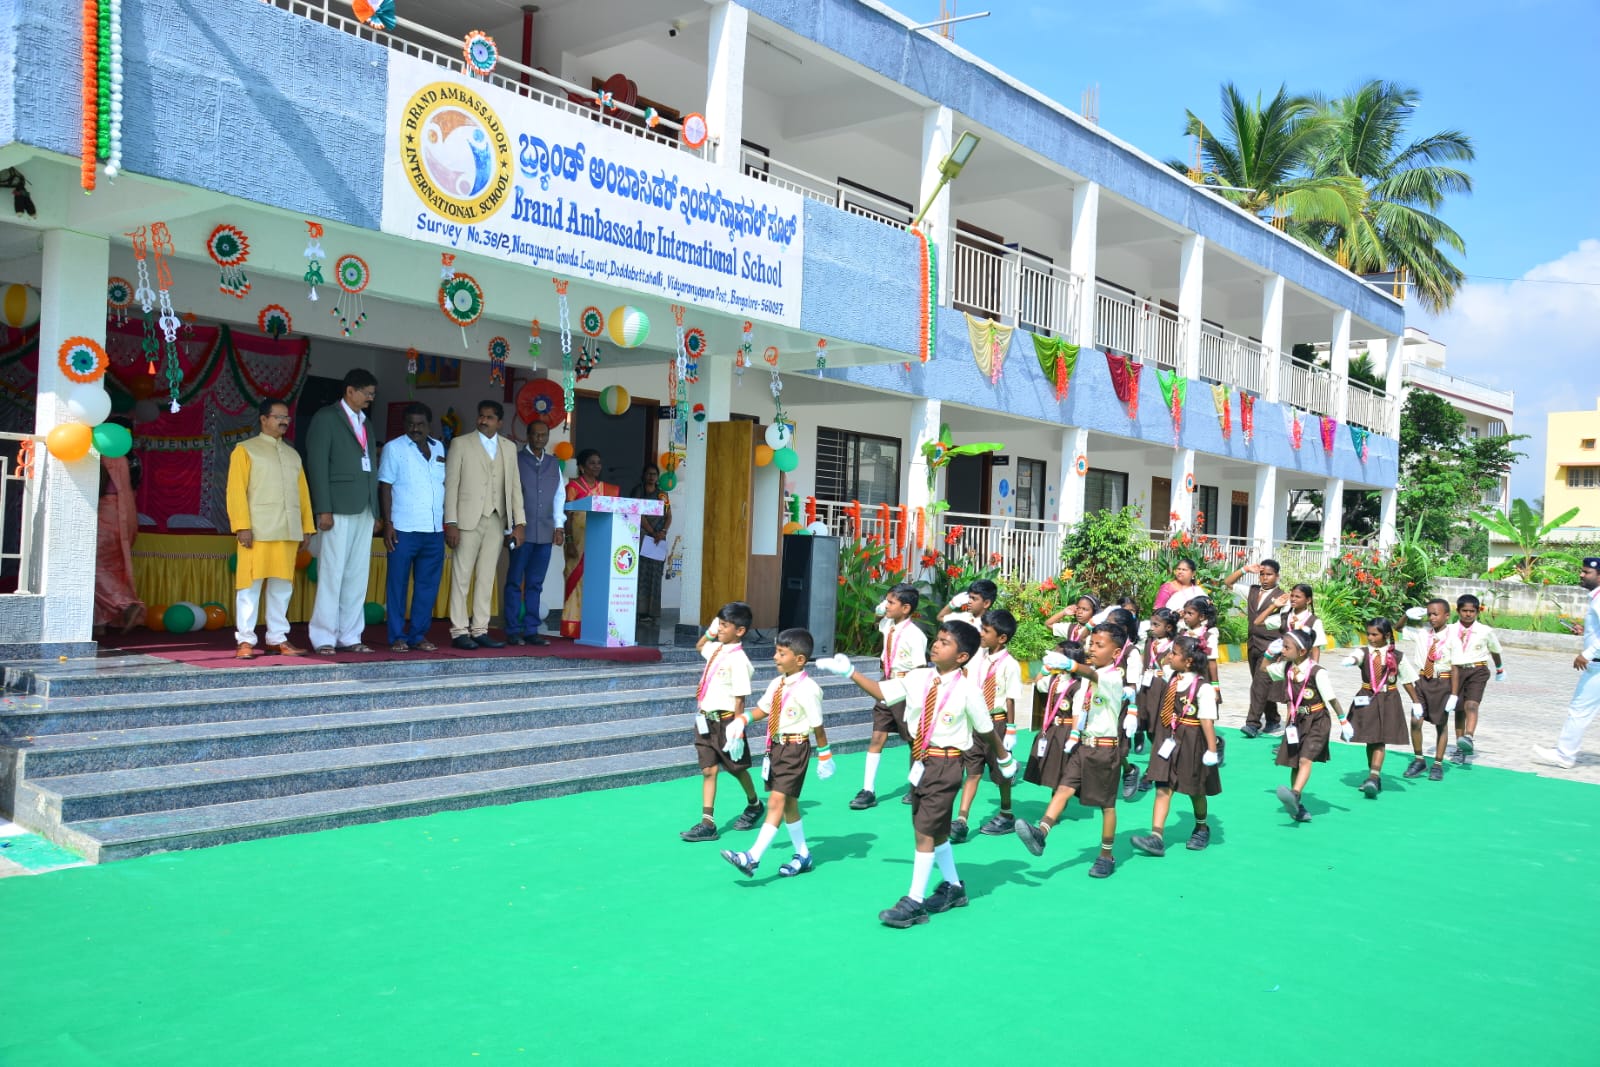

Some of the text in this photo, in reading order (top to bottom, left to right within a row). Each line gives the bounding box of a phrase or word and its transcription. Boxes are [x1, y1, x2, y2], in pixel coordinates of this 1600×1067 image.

[406, 87, 508, 154] BRAND AMBASSADOR
[406, 146, 509, 219] INTERNATIONAL SCHOOL
[416, 212, 462, 246] Survey
[555, 245, 579, 268] Gowda
[510, 184, 783, 288] Brand Ambassador International School
[224, 431, 251, 443] DAY
